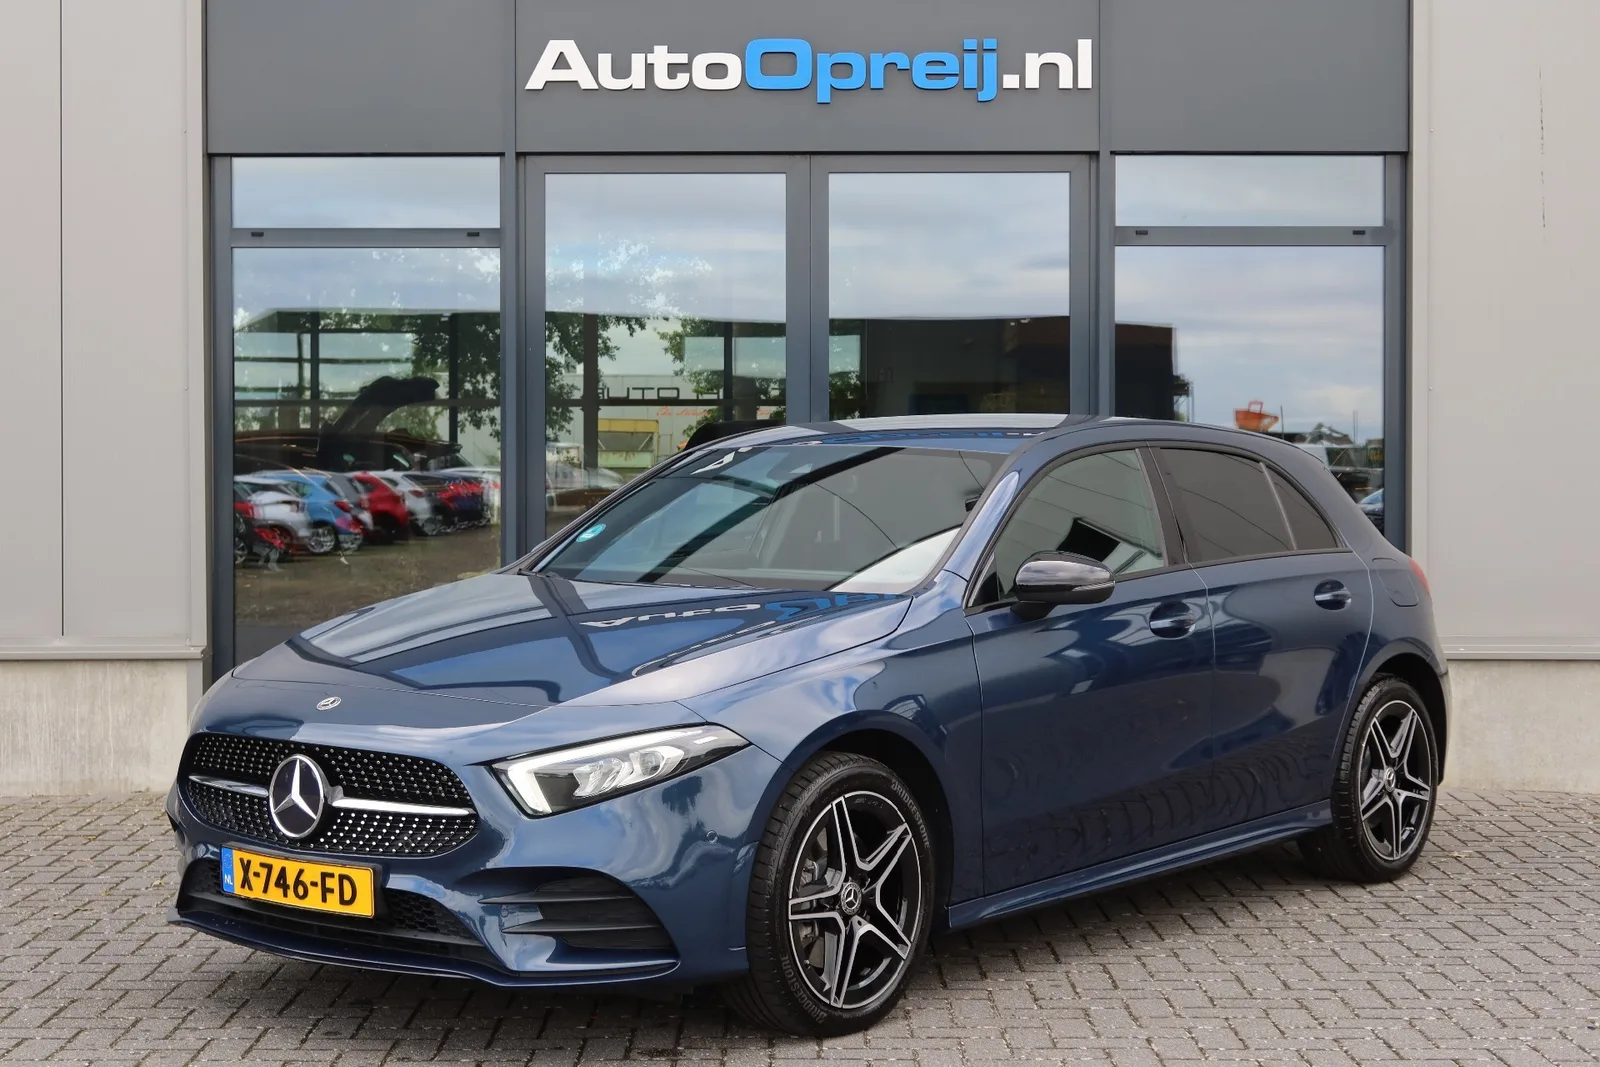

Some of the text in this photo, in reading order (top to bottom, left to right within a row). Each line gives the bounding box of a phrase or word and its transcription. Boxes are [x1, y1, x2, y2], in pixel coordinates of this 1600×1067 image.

[524, 38, 1092, 104] AutoOpreij.nl
[224, 873, 233, 886] NL
[239, 857, 357, 906] X-746-FD
